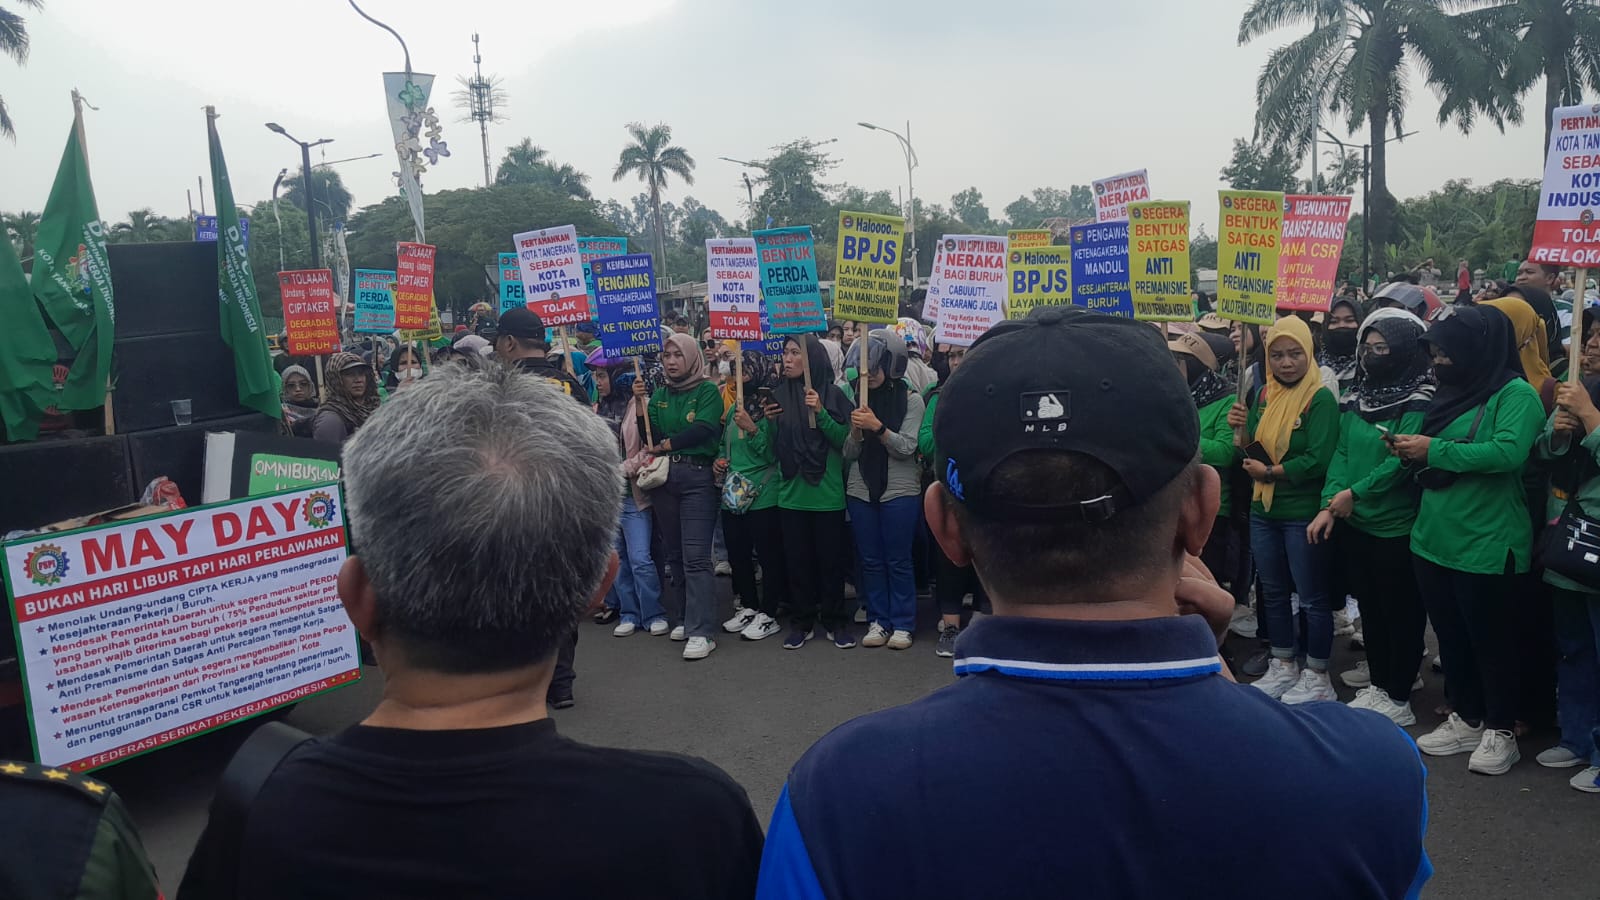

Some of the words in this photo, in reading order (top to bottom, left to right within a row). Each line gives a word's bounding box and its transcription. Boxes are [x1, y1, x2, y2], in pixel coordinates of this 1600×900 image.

[1556, 135, 1579, 152] KOTA
[1099, 186, 1149, 209] NERAKA
[1233, 197, 1277, 212] SEGERA
[1548, 191, 1600, 207] INDUS
[1100, 208, 1119, 221] BAGI
[1142, 207, 1184, 220] SEGERA
[1295, 200, 1348, 217] MENUNTUT
[1135, 223, 1187, 237] BENTUK
[1225, 214, 1279, 231] BENTUK
[1281, 220, 1346, 240] RANSFARANSI
[1228, 231, 1275, 249] SATGAS
[1562, 228, 1600, 243] TOLA
[522, 249, 537, 261] KOTA
[539, 244, 577, 258] TANGERANG
[843, 235, 897, 265] BPJS
[986, 241, 1004, 254] KERJA
[1138, 239, 1185, 252] SATGAS
[1311, 243, 1338, 259] CSR
[724, 257, 757, 268] TANGERANG
[762, 246, 812, 263] BENTUK
[947, 253, 1003, 269] NERAKA
[1234, 251, 1261, 272] ANTI
[529, 257, 573, 271] SEBAGAI
[606, 258, 648, 270] KEMBALIKAN
[1085, 260, 1124, 275] MANDUL
[1146, 257, 1173, 275] ANTI
[1283, 263, 1314, 275] UNTUK
[291, 273, 328, 285] TOLAAAK
[538, 269, 566, 282] KOTA
[716, 271, 753, 280] SEBAGAI
[767, 265, 809, 283] PERDA
[839, 264, 872, 277] LAYANI
[874, 269, 898, 281] KAMI
[944, 269, 967, 280] BAGI
[969, 271, 1003, 282] BURUH
[529, 278, 580, 294] INDUSTRI
[598, 273, 650, 292] PENGAWAS
[722, 282, 745, 292] KOTA
[839, 277, 859, 288] DENGAN
[878, 281, 897, 292] MUDAH
[1013, 269, 1068, 294] BPJS
[1135, 281, 1187, 295] PREMANISME
[1223, 274, 1273, 295] PREMANISME
[360, 292, 389, 303] PERDA
[713, 294, 754, 303] INDUSTRI
[839, 290, 854, 300] DAN
[855, 292, 896, 305] MANUSIAWI
[941, 298, 978, 310] SEKARANG
[979, 300, 998, 312] JUGA
[1010, 298, 1044, 309] LAYANI
[1088, 297, 1119, 309] BURUH
[1301, 293, 1328, 305] BURUH
[235, 288, 258, 332] INDONESIA
[288, 302, 329, 314] CIPTAKER
[542, 301, 576, 314] TOLAK
[623, 304, 654, 315] PROVINSI
[838, 303, 857, 315] TANPA
[857, 305, 895, 319] DISKRIMINASI
[1221, 298, 1235, 314] CALO
[1234, 299, 1255, 317] TENAGA
[1255, 303, 1272, 319] KERJA
[290, 319, 334, 328] DEGRADASI
[603, 323, 616, 333] KE
[618, 318, 657, 331] TINGKAT
[723, 316, 750, 326] TOLAK
[631, 331, 659, 342] KOTA
[714, 329, 758, 340] RELOKASI
[296, 341, 330, 351] BURUH
[606, 348, 621, 358] DAN
[621, 343, 661, 356] KABUPATEN
[80, 519, 194, 575] MAY
[211, 498, 302, 546] DAY
[24, 589, 85, 614] BUKAN
[89, 580, 128, 599] HARI
[133, 570, 179, 590] LIBUR
[182, 561, 218, 577] TAPI
[218, 552, 252, 570] HARI
[255, 533, 340, 562] PERLAWANAN
[48, 614, 96, 632] Menolak
[100, 593, 186, 617] Undang-undang
[188, 583, 218, 597] CIPTA
[221, 574, 255, 589] KERJA
[256, 570, 278, 582] yang
[280, 554, 340, 575] mendegradasi
[50, 617, 131, 642] Kesejahteraan
[134, 606, 174, 621] Pekerja
[52, 633, 107, 654] Mendesak
[111, 617, 170, 638] Pemerintah
[172, 608, 207, 622] Daerah
[209, 602, 235, 615] untuk
[237, 595, 269, 610] segera
[270, 581, 308, 597] membuat
[53, 652, 81, 666] yang
[84, 639, 130, 656] berpihak
[133, 631, 159, 645] pada
[161, 623, 188, 636] kaum
[190, 613, 220, 628] buruh
[249, 594, 293, 611] Penduduk
[294, 587, 321, 600] sekitar
[55, 658, 102, 675] usahaan
[136, 637, 177, 654] diterima
[214, 619, 247, 635] pekerja
[57, 668, 111, 688] Mendesak
[114, 651, 171, 672] Pemerintah
[173, 640, 208, 655] Daerah
[210, 632, 236, 645] untuk
[238, 624, 267, 637] segera
[269, 610, 316, 628] membentuk
[59, 686, 82, 699] Anti
[84, 668, 149, 691] Premanisme
[151, 661, 170, 673] dan
[172, 651, 204, 668] Satgas
[206, 645, 225, 656] Anti
[227, 632, 271, 650] Percaloan
[273, 624, 302, 638] Tenaga
[60, 692, 113, 712] Mendesak
[115, 676, 171, 696] Pemerintah
[173, 666, 199, 679] untuk
[201, 658, 232, 671] segera
[234, 638, 298, 663] mengembalikan
[62, 709, 96, 723] wasan
[99, 684, 180, 712] Ketenagakerjaan
[182, 676, 200, 688] dari
[202, 666, 239, 681] Provinsi
[253, 648, 296, 666] Kabupaten
[65, 716, 115, 737] Menuntut
[118, 696, 179, 719] transparansi
[181, 685, 217, 701] Pemkot
[218, 670, 264, 689] Tangerang
[266, 659, 297, 674] tentang
[298, 646, 344, 666] penerimaan
[66, 737, 87, 749] dan
[89, 715, 152, 743] penggunaan
[154, 707, 180, 720] Dana
[182, 699, 203, 712] CSR
[205, 689, 231, 703] untuk
[232, 672, 291, 695] kesejahteraan
[293, 663, 322, 678] pekerja
[92, 737, 158, 765] FEDERASI
[160, 718, 212, 743] SERIKAT
[216, 700, 269, 723] PEKERJA
[271, 681, 327, 704] INDONESIA
